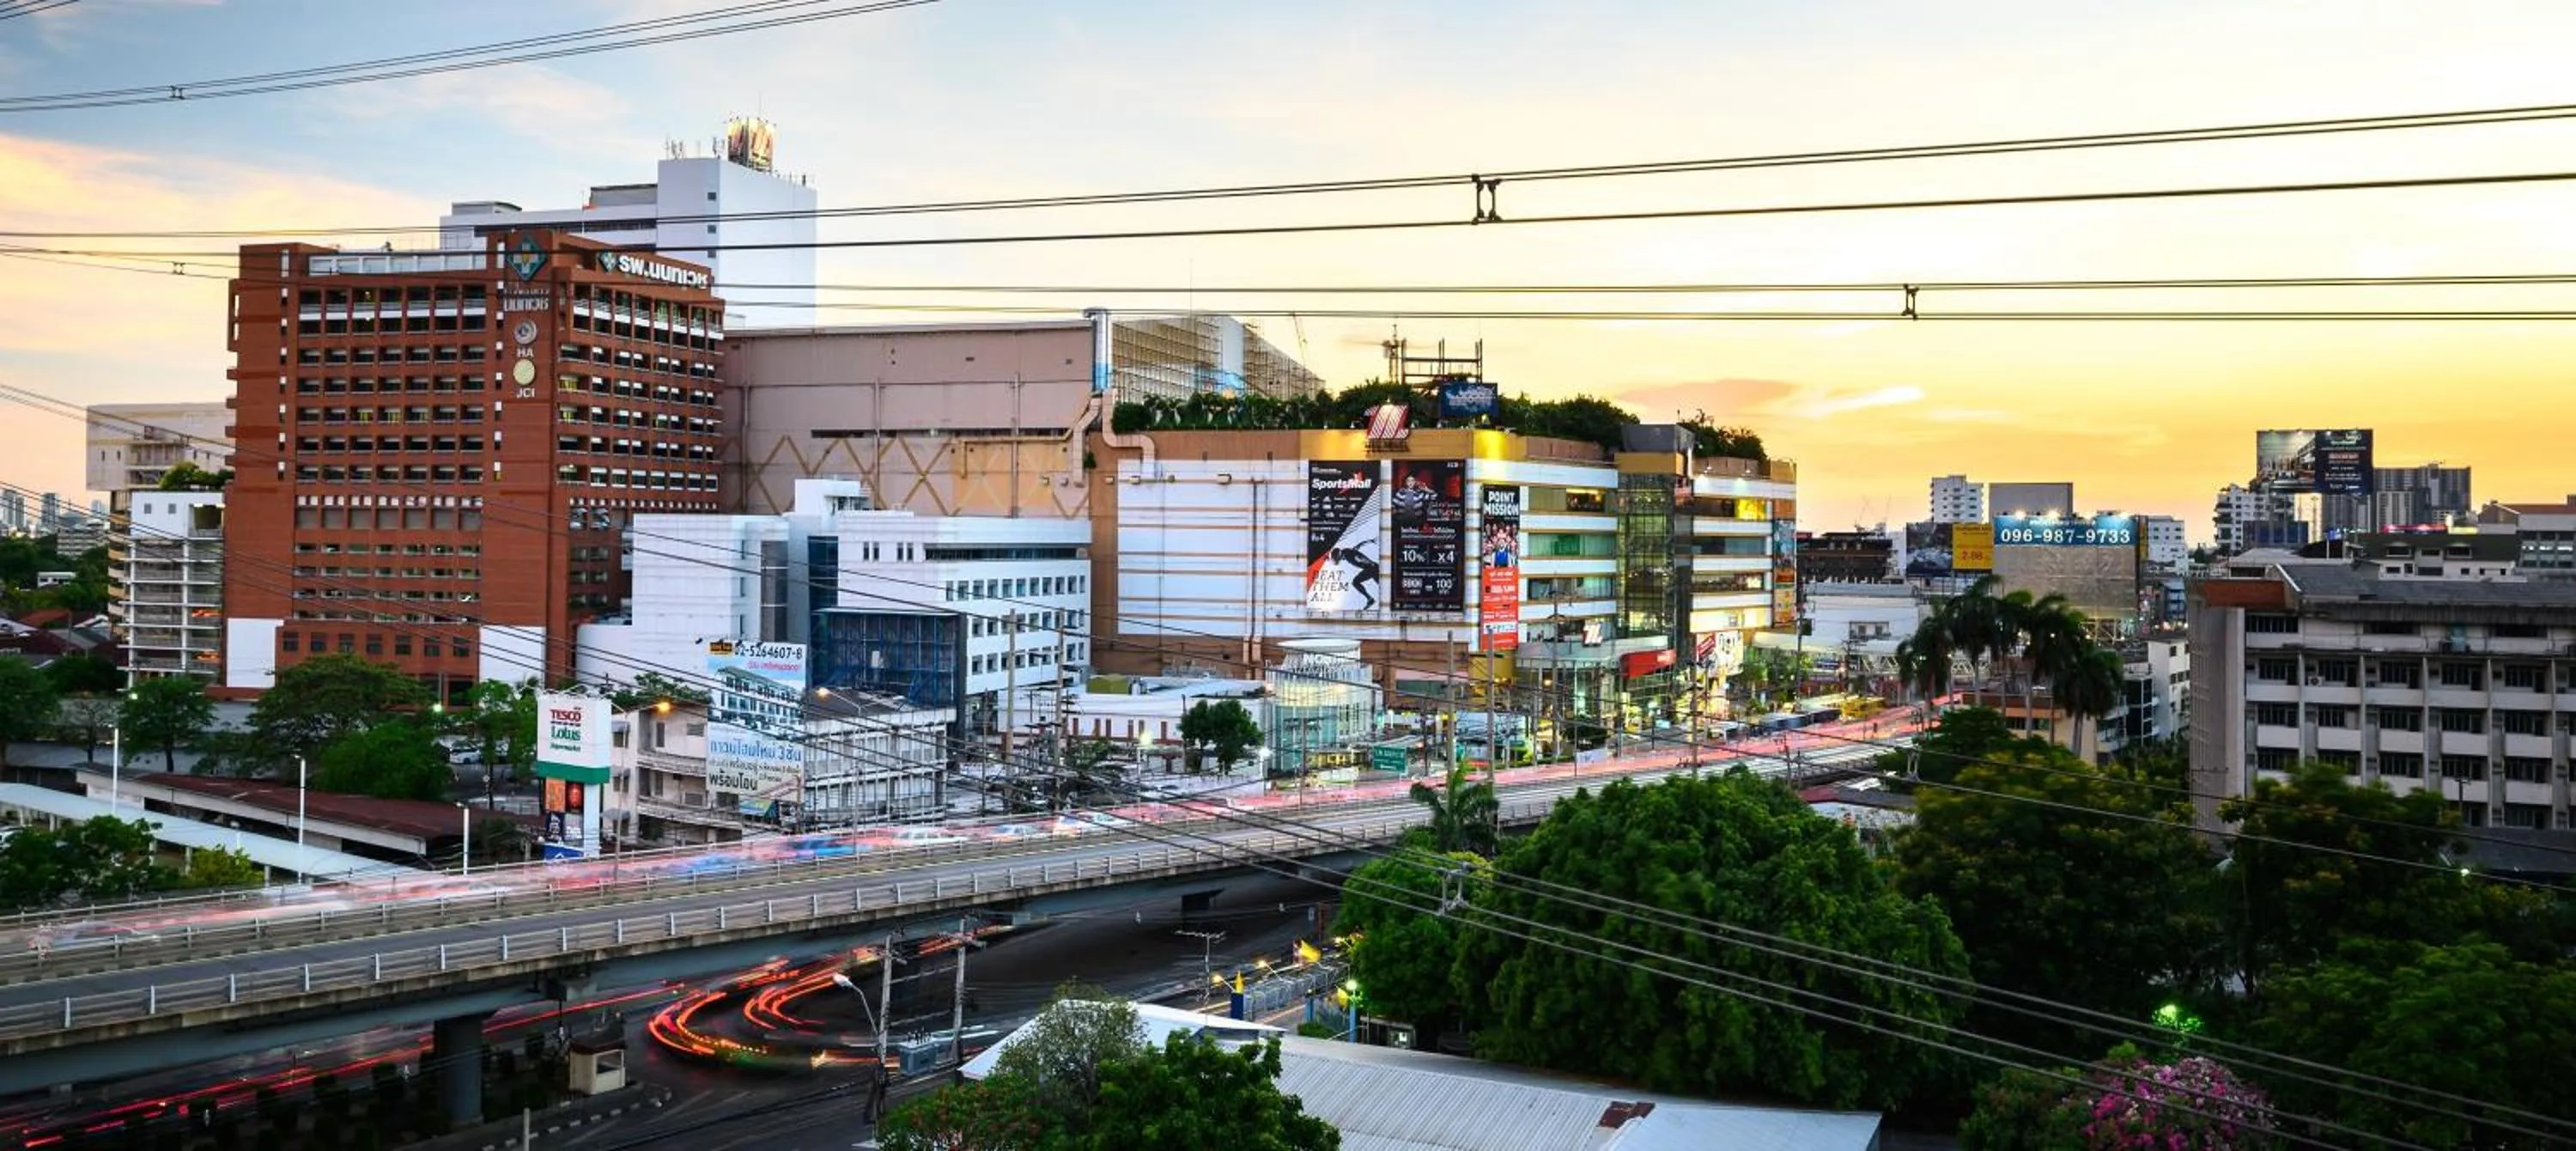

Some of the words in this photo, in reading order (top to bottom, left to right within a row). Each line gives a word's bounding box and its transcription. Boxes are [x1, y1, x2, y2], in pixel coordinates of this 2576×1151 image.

[517, 347, 534, 357] HA
[517, 387, 535, 399] JCI
[1488, 490, 1516, 502] POINT
[1483, 502, 1519, 515] MISSION
[2001, 528, 2130, 544] 096-987-9733
[550, 709, 581, 722] TESCO
[551, 725, 580, 740] Lotus
